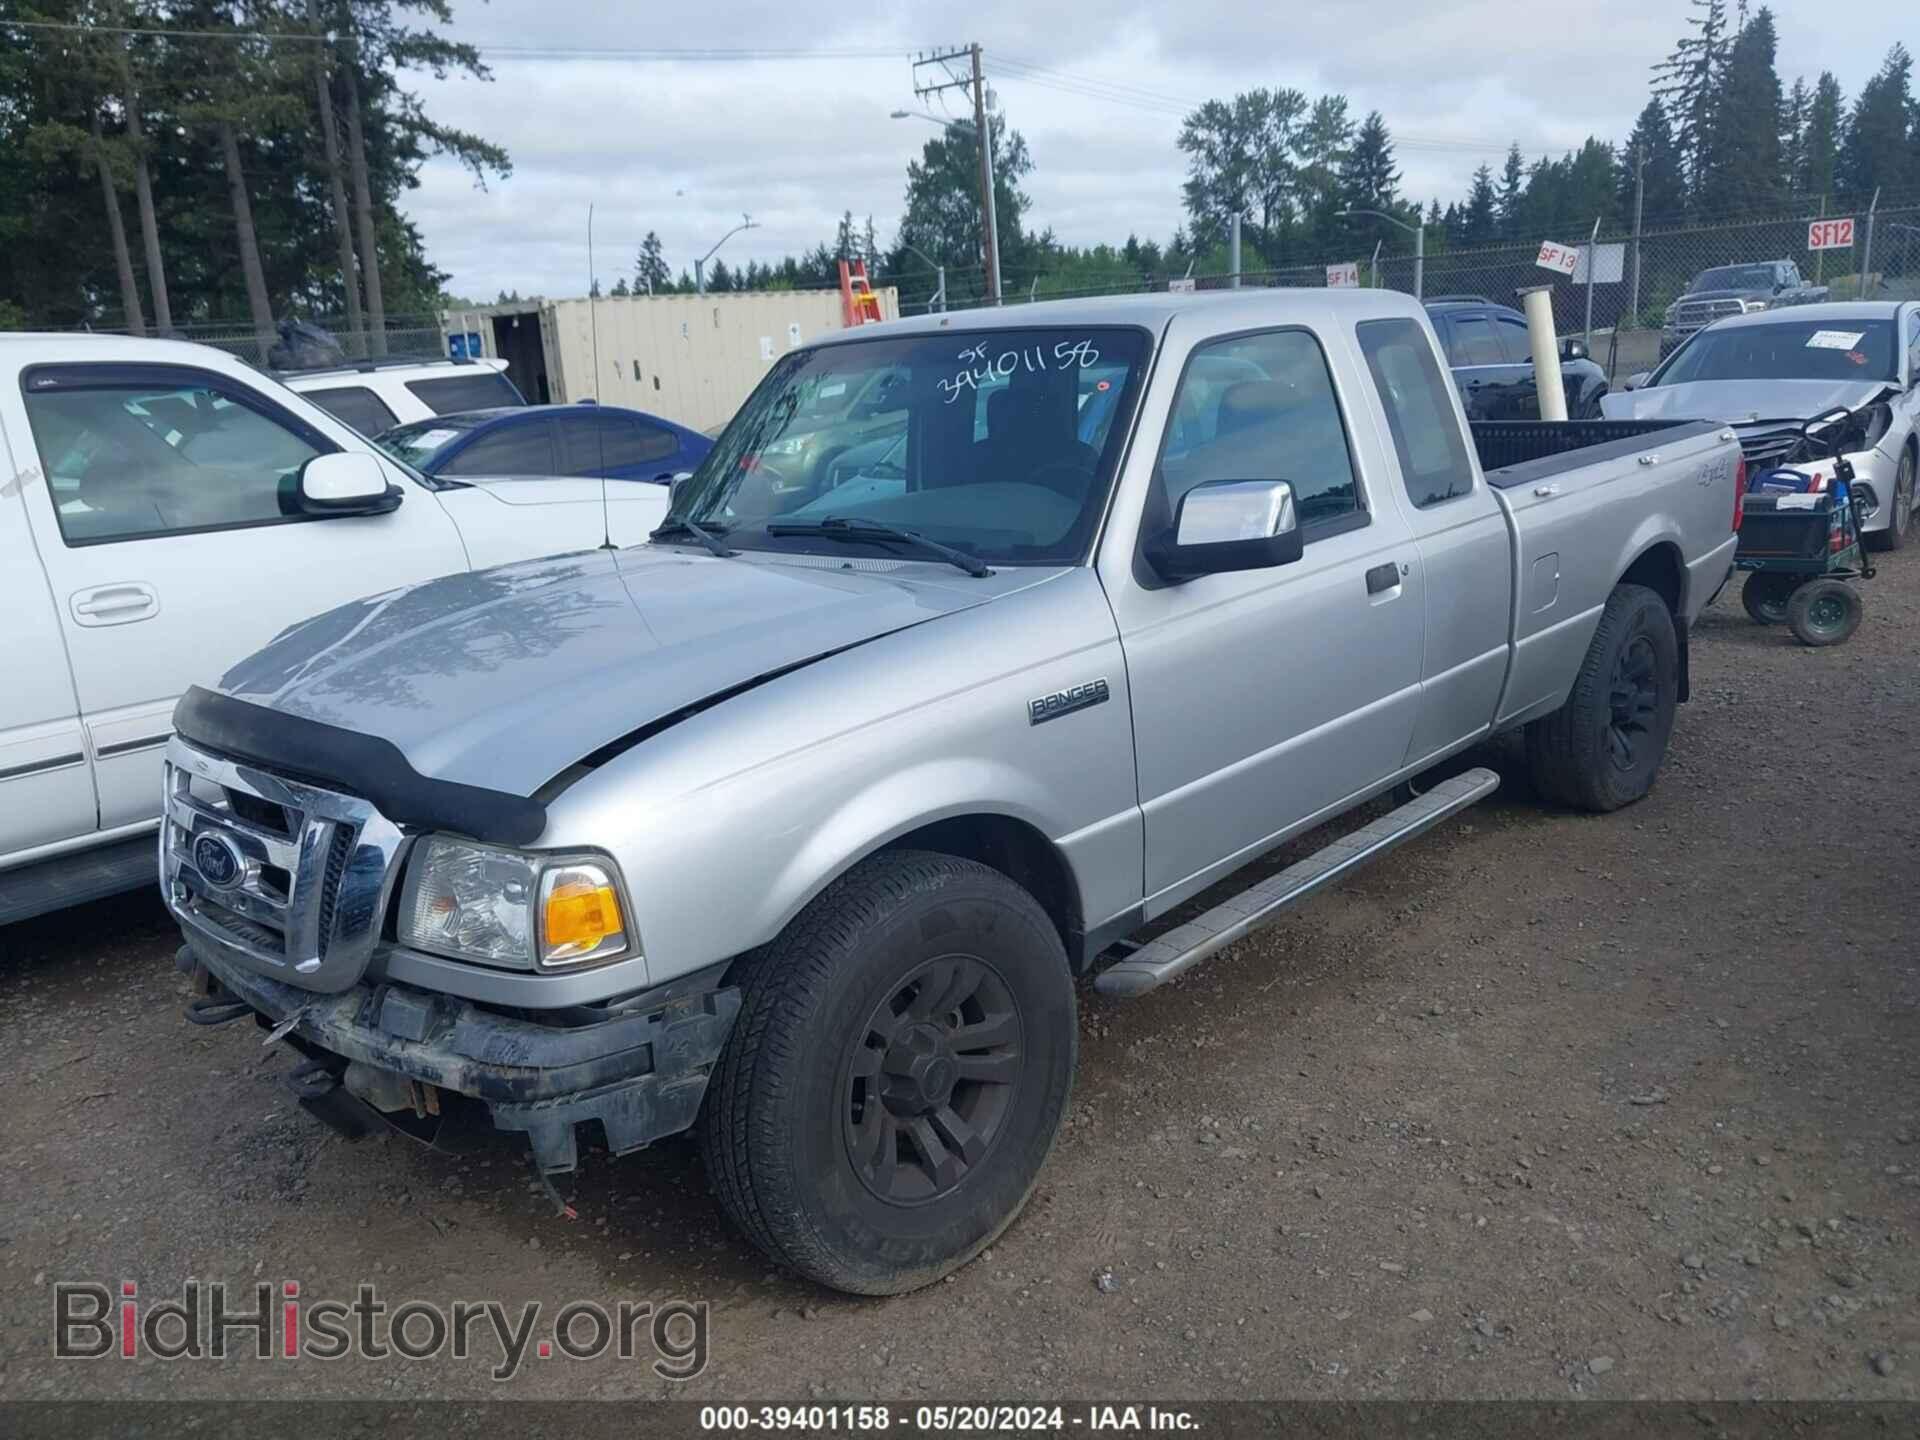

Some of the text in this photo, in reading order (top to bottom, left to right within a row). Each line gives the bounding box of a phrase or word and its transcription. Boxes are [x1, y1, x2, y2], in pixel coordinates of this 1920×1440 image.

[1811, 222, 1851, 247] SF12
[958, 340, 988, 364] SF
[1031, 679, 1108, 717] RANGER
